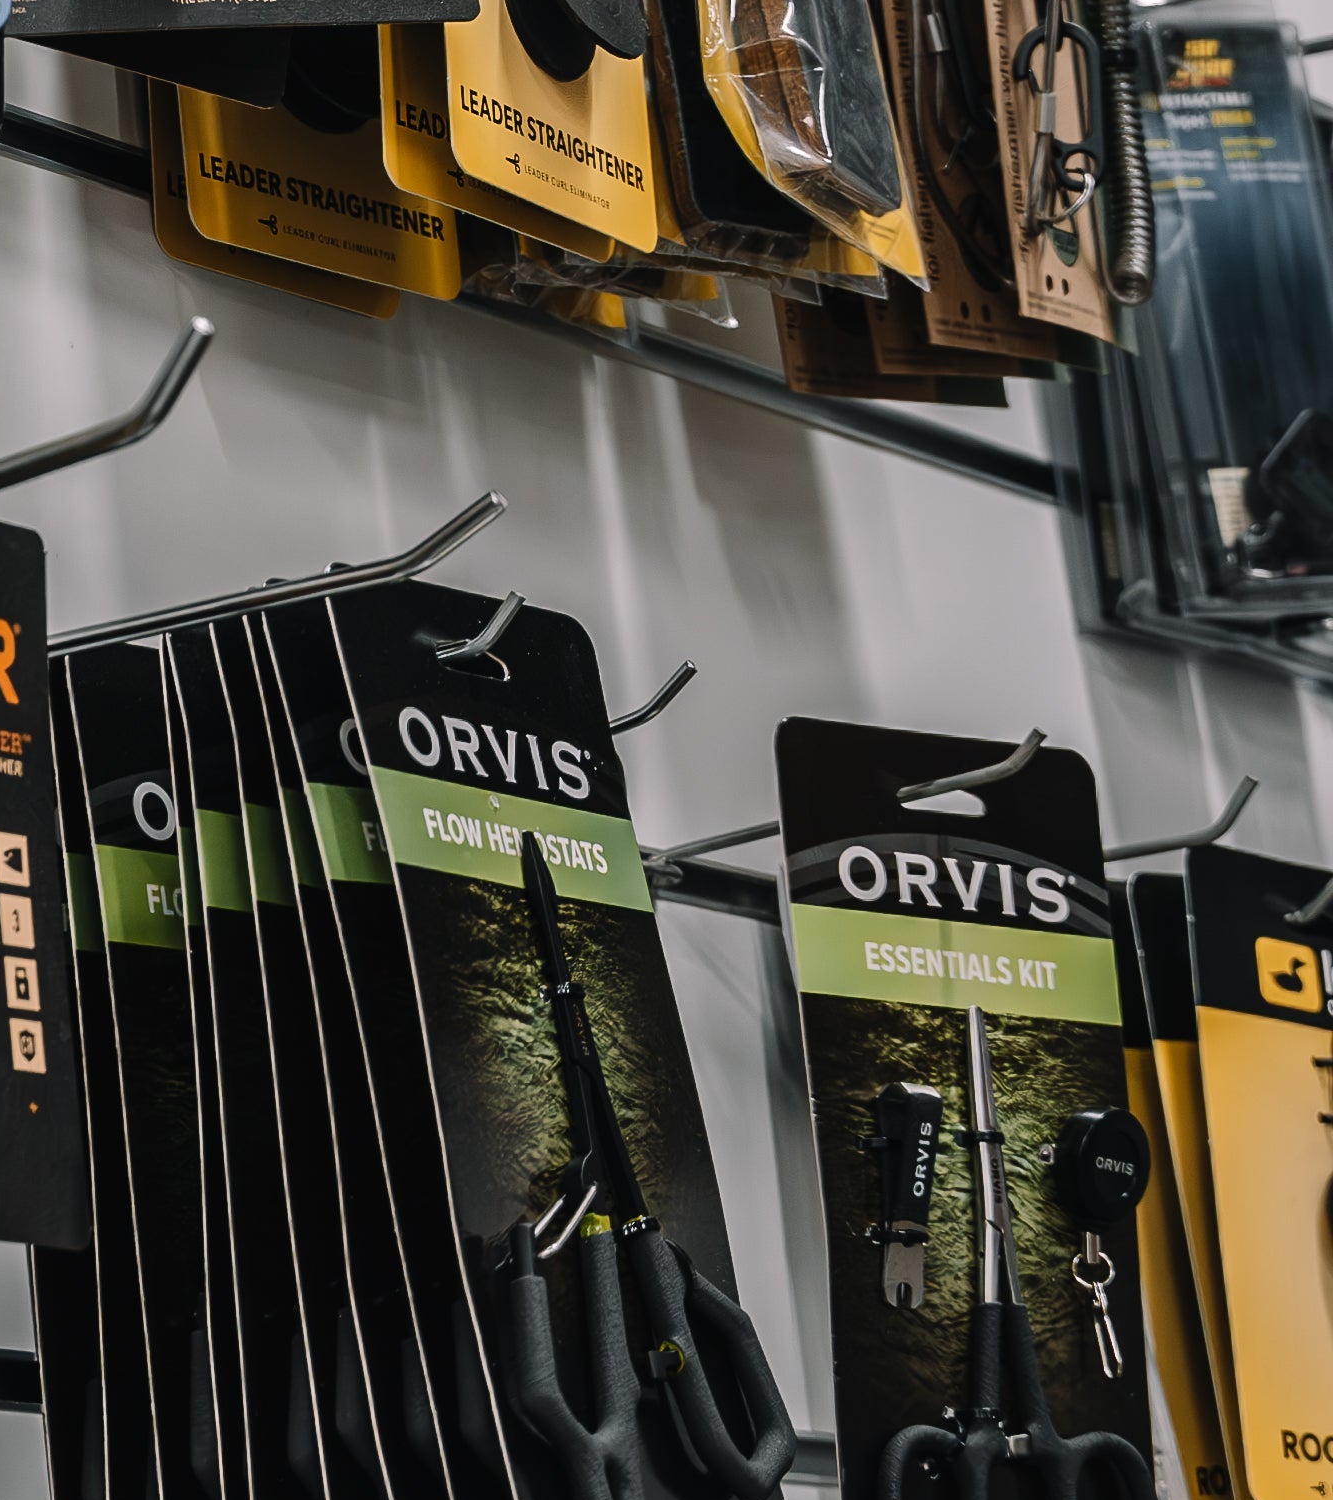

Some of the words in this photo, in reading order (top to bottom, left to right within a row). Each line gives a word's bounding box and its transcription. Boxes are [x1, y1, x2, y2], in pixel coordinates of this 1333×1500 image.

[395, 99, 450, 141] LEAD
[460, 84, 524, 140] LEADER
[526, 114, 646, 193] STRAIGHTENER
[198, 152, 283, 199] LEADER
[285, 176, 445, 242] STRAIGHTENER
[422, 807, 484, 850] FLOW
[838, 845, 1071, 924] ORVIS
[864, 941, 1014, 986] ESSENTIALS
[1018, 958, 1058, 990] KIT
[912, 1121, 933, 1198] ORVIS
[1095, 1155, 1134, 1176] ORVIS
